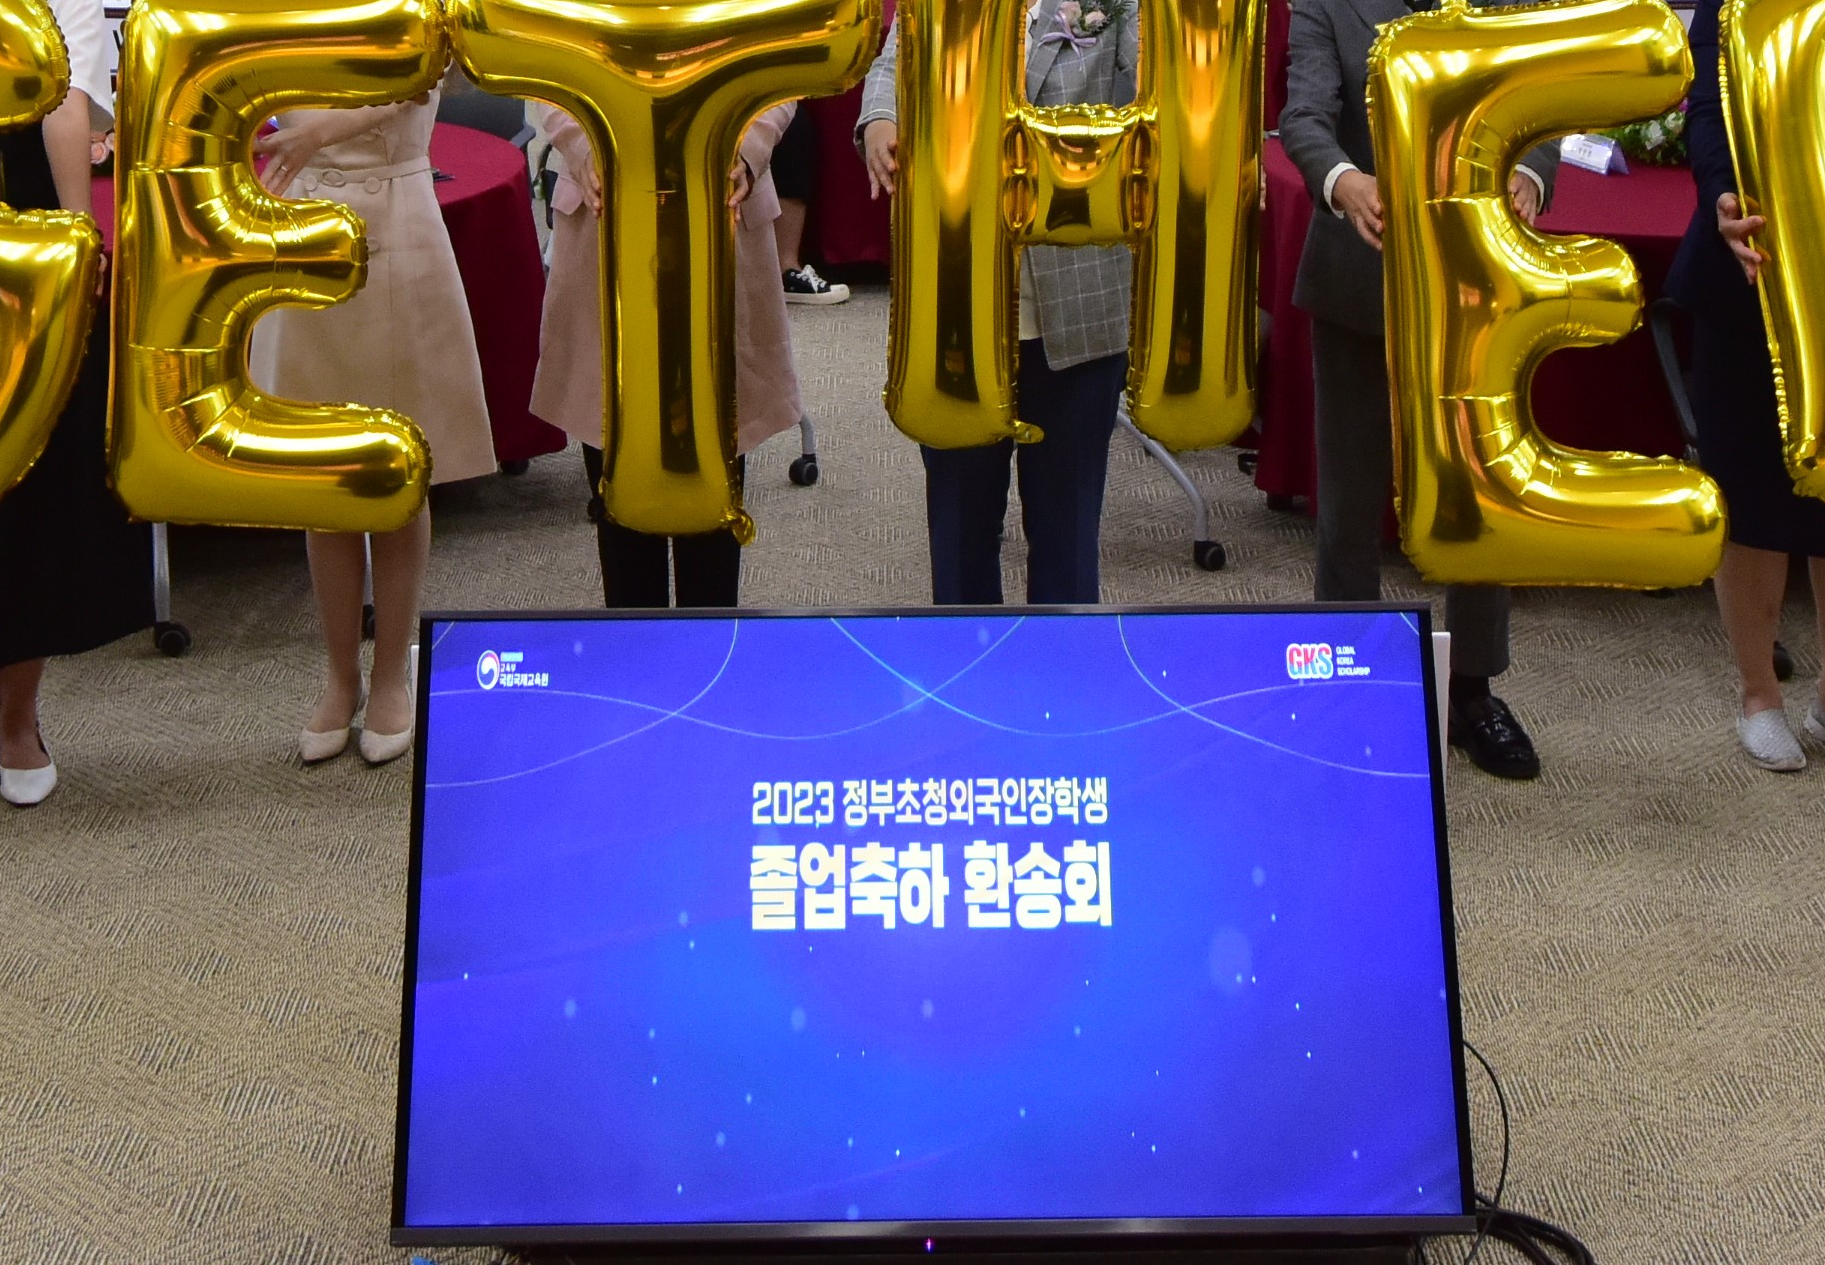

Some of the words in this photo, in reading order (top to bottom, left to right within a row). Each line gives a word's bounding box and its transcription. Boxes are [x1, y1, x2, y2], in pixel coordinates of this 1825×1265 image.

[1287, 643, 1333, 680] GKS
[752, 781, 834, 824] 2023
[842, 776, 1108, 826] 정부초청외국인장학생
[749, 841, 950, 930] 졸업축하
[964, 840, 1113, 929] 환송회
